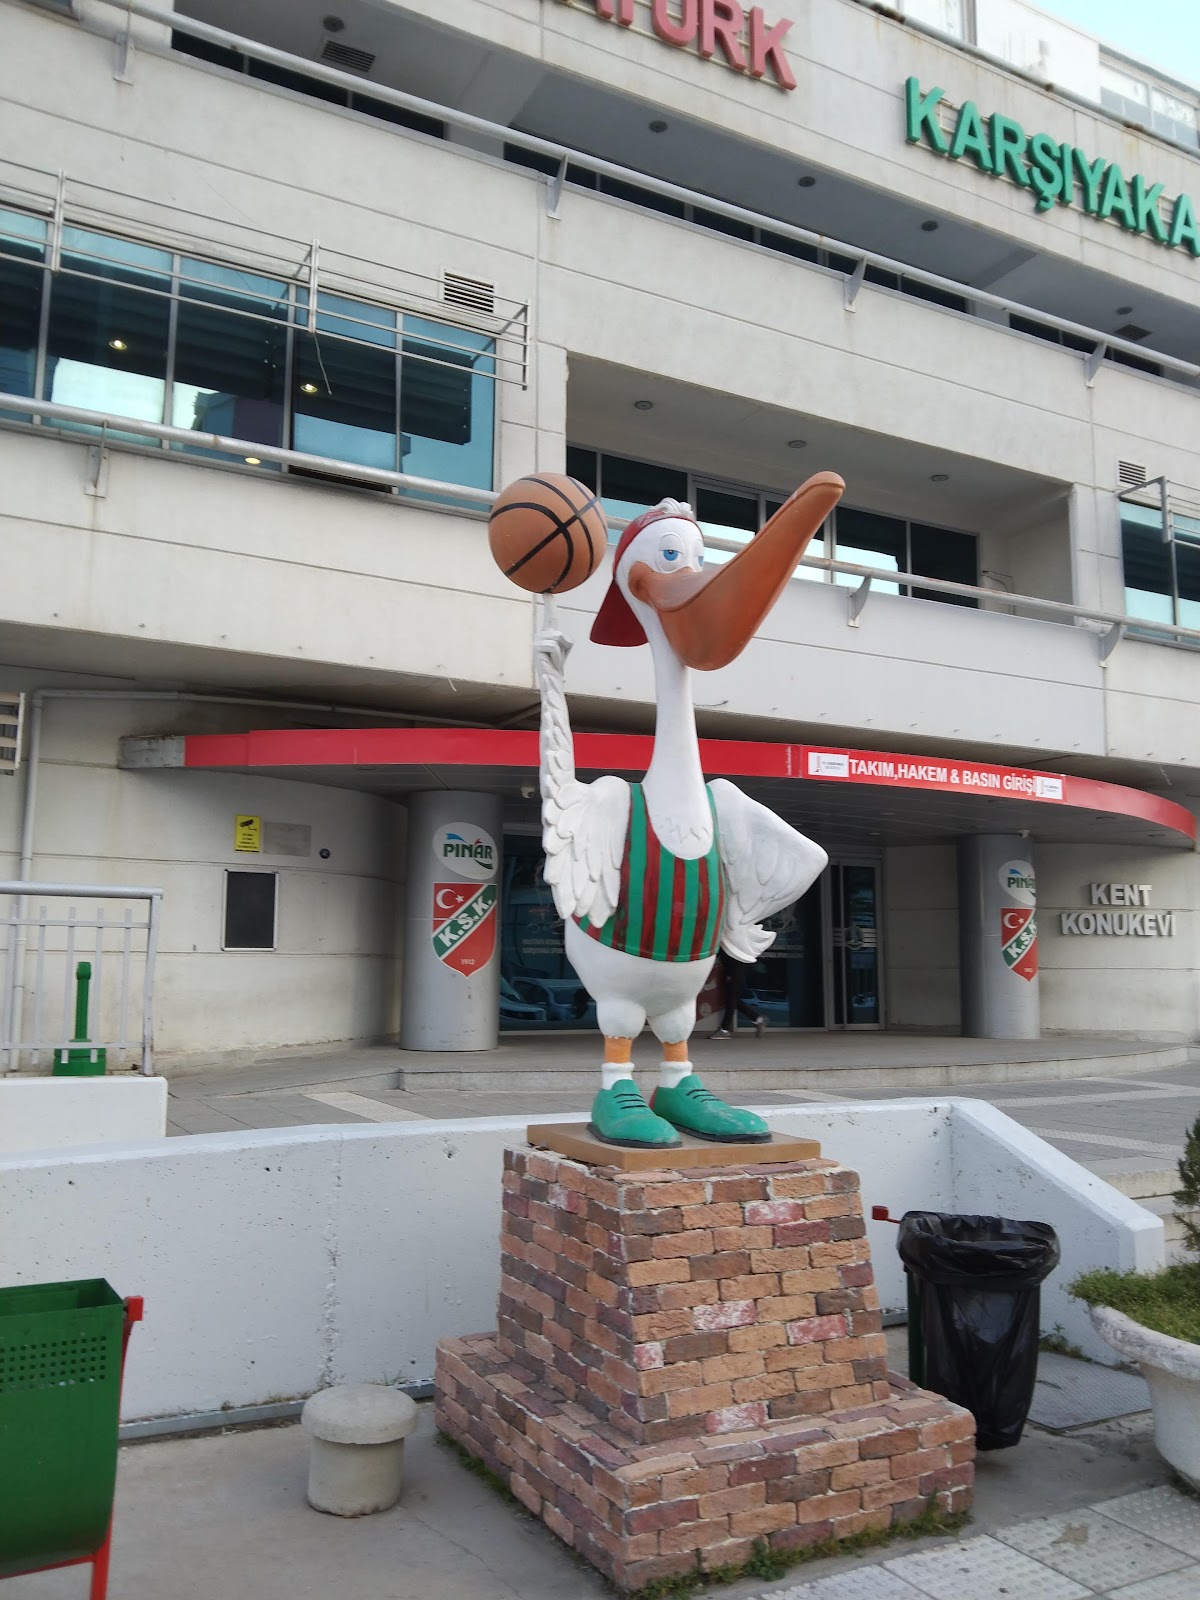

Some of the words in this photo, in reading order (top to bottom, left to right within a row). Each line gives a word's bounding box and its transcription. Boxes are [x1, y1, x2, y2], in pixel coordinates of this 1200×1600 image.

[905, 76, 1200, 257] KARŞIYAKA
[950, 769, 960, 783] &
[963, 770, 1000, 788] BASIN
[1089, 883, 1152, 906] KENT
[1059, 911, 1176, 936] KONUKEVİ
